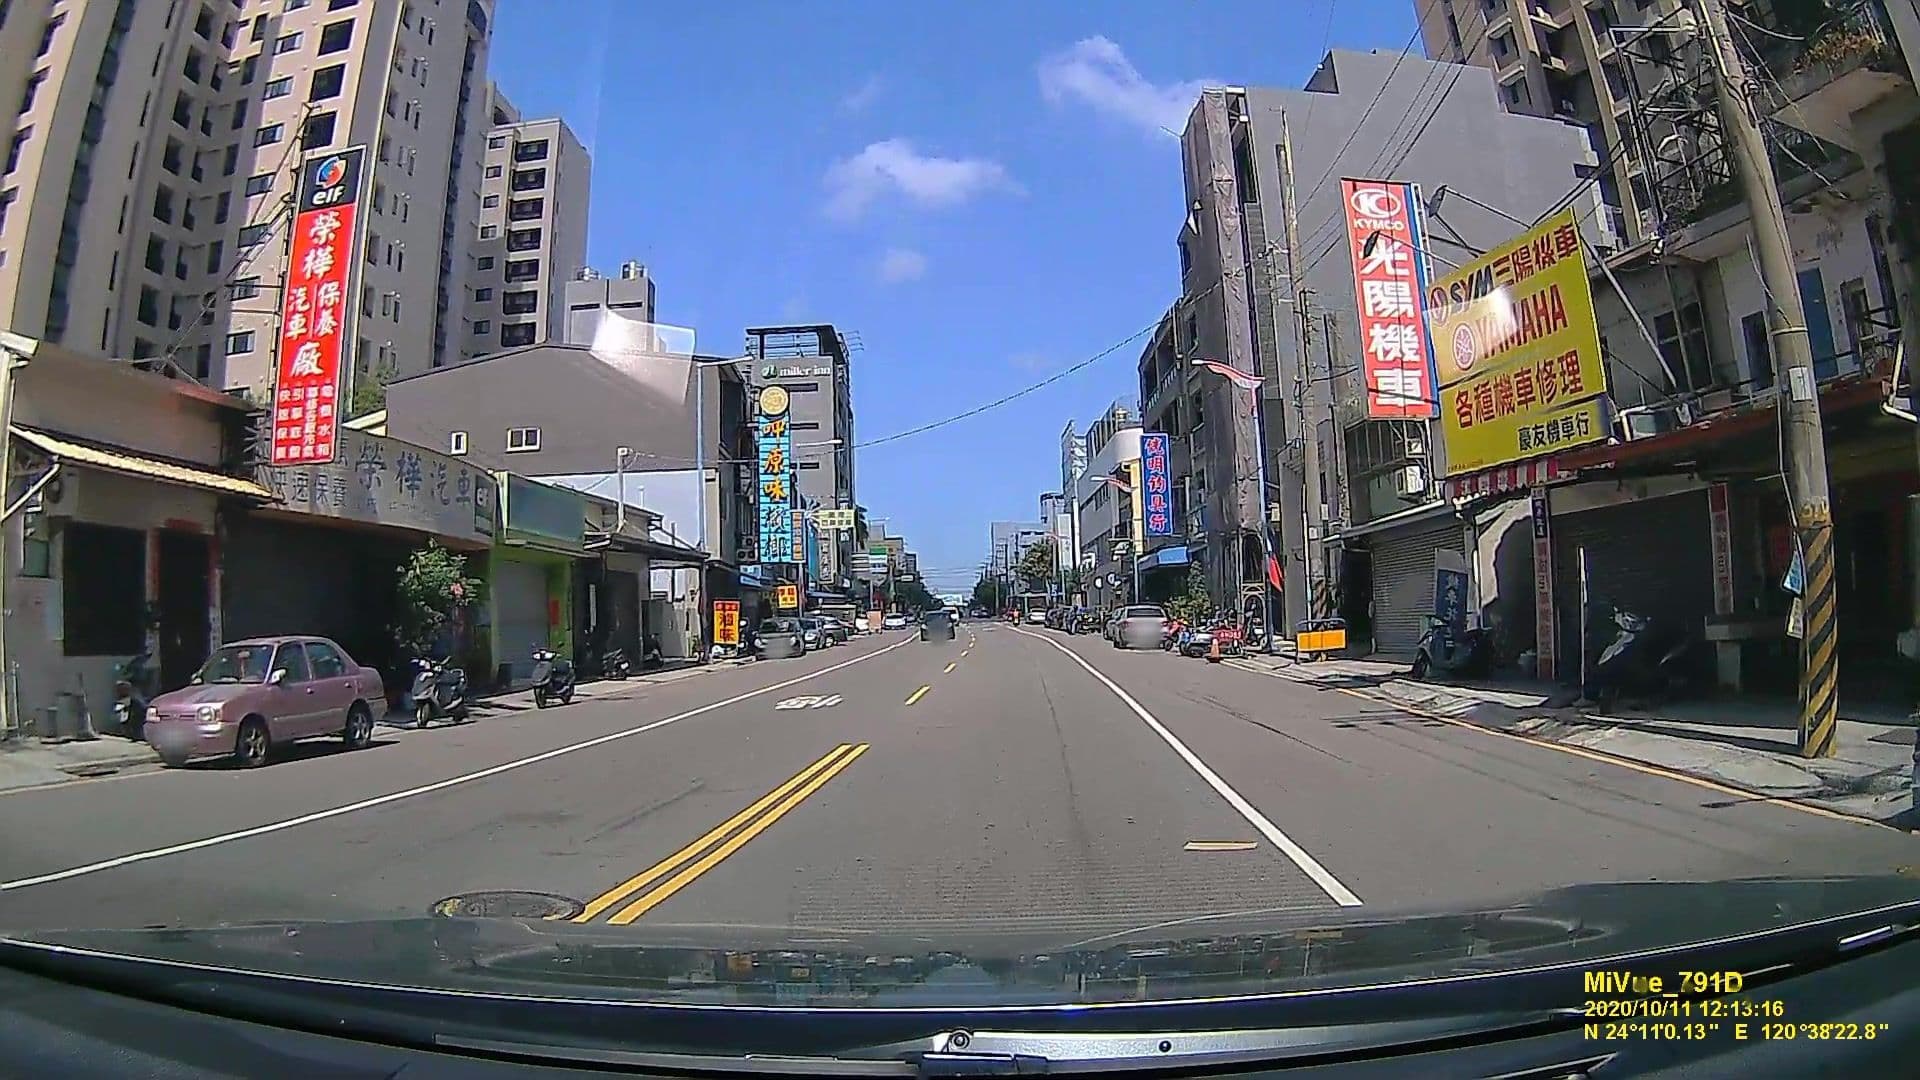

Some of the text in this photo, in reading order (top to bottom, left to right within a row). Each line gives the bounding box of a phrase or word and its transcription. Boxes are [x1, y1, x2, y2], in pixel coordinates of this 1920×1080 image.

[312, 186, 345, 206] elf
[1353, 217, 1405, 231] KYMCO
[1450, 223, 1579, 314] SYM 三陽機車
[285, 287, 312, 339] 汽車
[317, 281, 341, 337] 保養
[1359, 236, 1426, 408] 光陽機車
[1475, 283, 1569, 359] YAMAHA
[291, 340, 325, 376] 廠
[813, 365, 831, 376] inn
[1455, 350, 1584, 429] 各種機車修理
